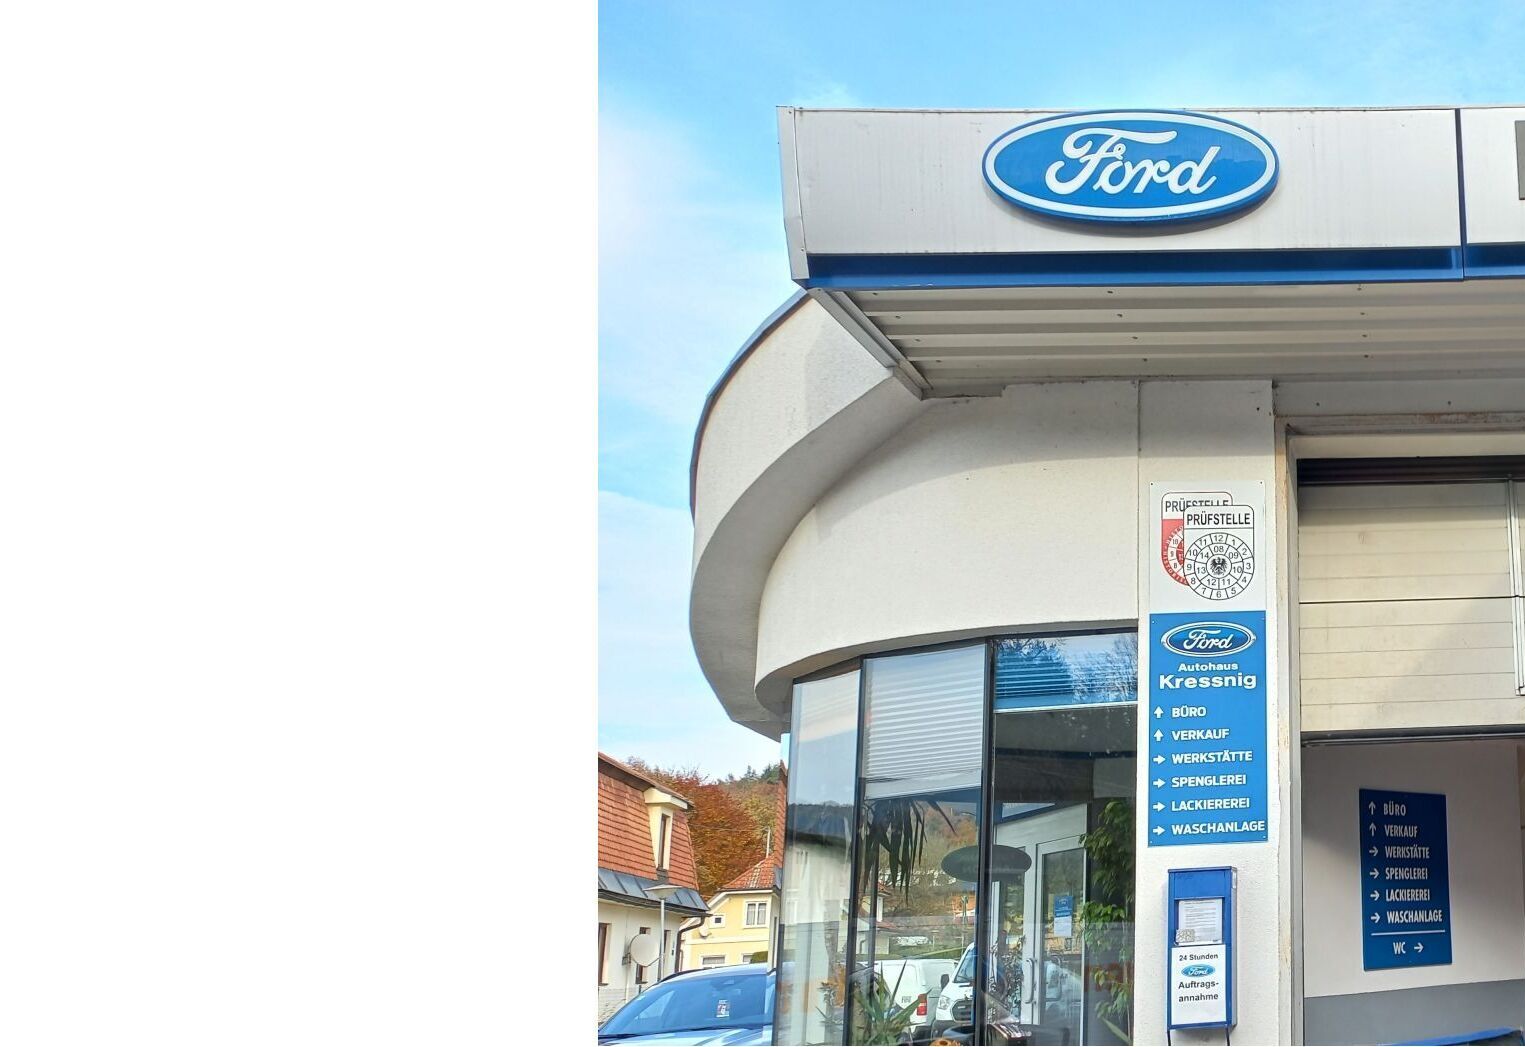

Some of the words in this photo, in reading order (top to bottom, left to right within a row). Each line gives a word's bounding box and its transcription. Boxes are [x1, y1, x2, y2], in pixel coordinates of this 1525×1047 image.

[1045, 127, 1221, 195] Ford
[1186, 510, 1251, 525] PRÜFSTELLE
[1189, 548, 1198, 557] 10
[1213, 545, 1224, 553] 08
[1241, 548, 1247, 556] 2
[1197, 566, 1206, 574] 13
[1246, 562, 1251, 570] 3
[1190, 577, 1196, 585] 8
[1207, 578, 1216, 586] 12
[1222, 578, 1231, 586] 11
[1201, 587, 1207, 595] 7
[1216, 590, 1222, 598] 6
[1230, 587, 1237, 595] 5
[1182, 629, 1234, 650] Ford
[1177, 662, 1239, 672] Autohaus
[1159, 672, 1257, 690] Kressnig
[1171, 705, 1207, 718] BÜRO
[1171, 728, 1230, 741] VERKAUF
[1171, 750, 1253, 764] WERKSTÄTTE
[1171, 774, 1247, 788] SPENGLEREI
[1171, 797, 1250, 812] LACKIEREREI
[1383, 800, 1407, 816] BÜRO
[1171, 820, 1265, 835] WASCHANLAGE
[1384, 824, 1418, 838] VERKAUF
[1385, 844, 1430, 859] WERKSTÄTTE
[1385, 867, 1428, 881] SPENGLEREI
[1385, 888, 1431, 902] LACKIEREREI
[1386, 909, 1443, 924] WASCHANLAGE
[1393, 941, 1406, 955] WC
[1189, 953, 1219, 961] Stunden
[1178, 980, 1219, 990] Auftrags-
[1178, 993, 1219, 1003] annahme
